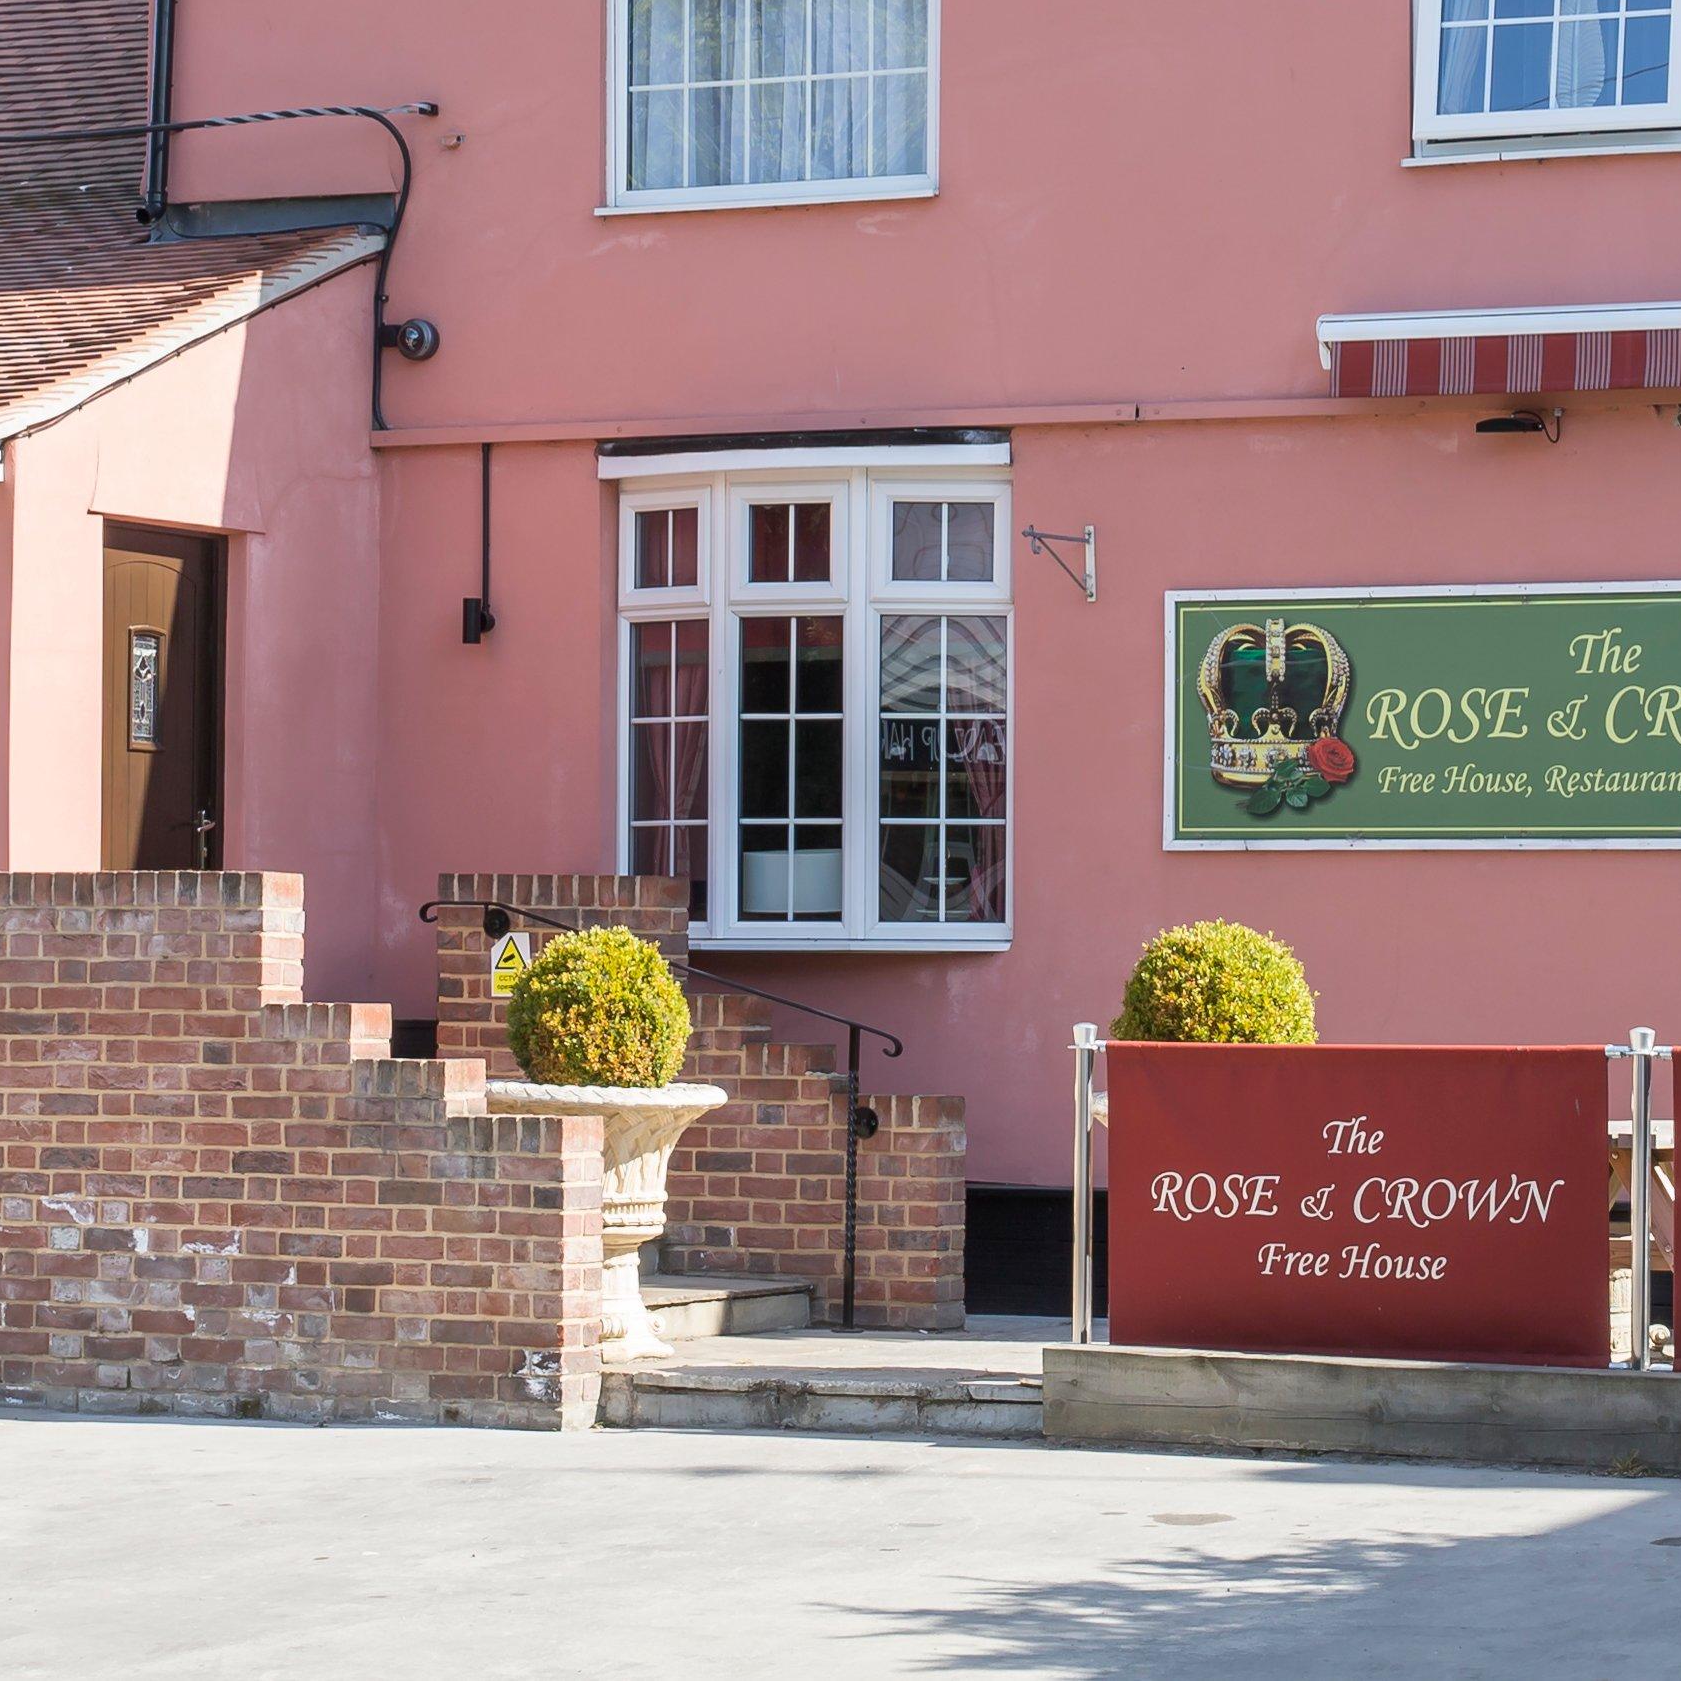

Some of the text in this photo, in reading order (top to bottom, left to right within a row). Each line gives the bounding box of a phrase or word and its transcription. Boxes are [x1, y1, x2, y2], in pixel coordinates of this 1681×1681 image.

[1568, 627, 1643, 675] The
[1365, 687, 1531, 750] ROSE
[1546, 694, 1590, 741] &
[1376, 765, 1437, 794] Free
[1440, 762, 1534, 799] House,
[1322, 1114, 1385, 1155] The
[1150, 1170, 1567, 1229] ROSE & CROWN
[1257, 1241, 1449, 1281] Free House
